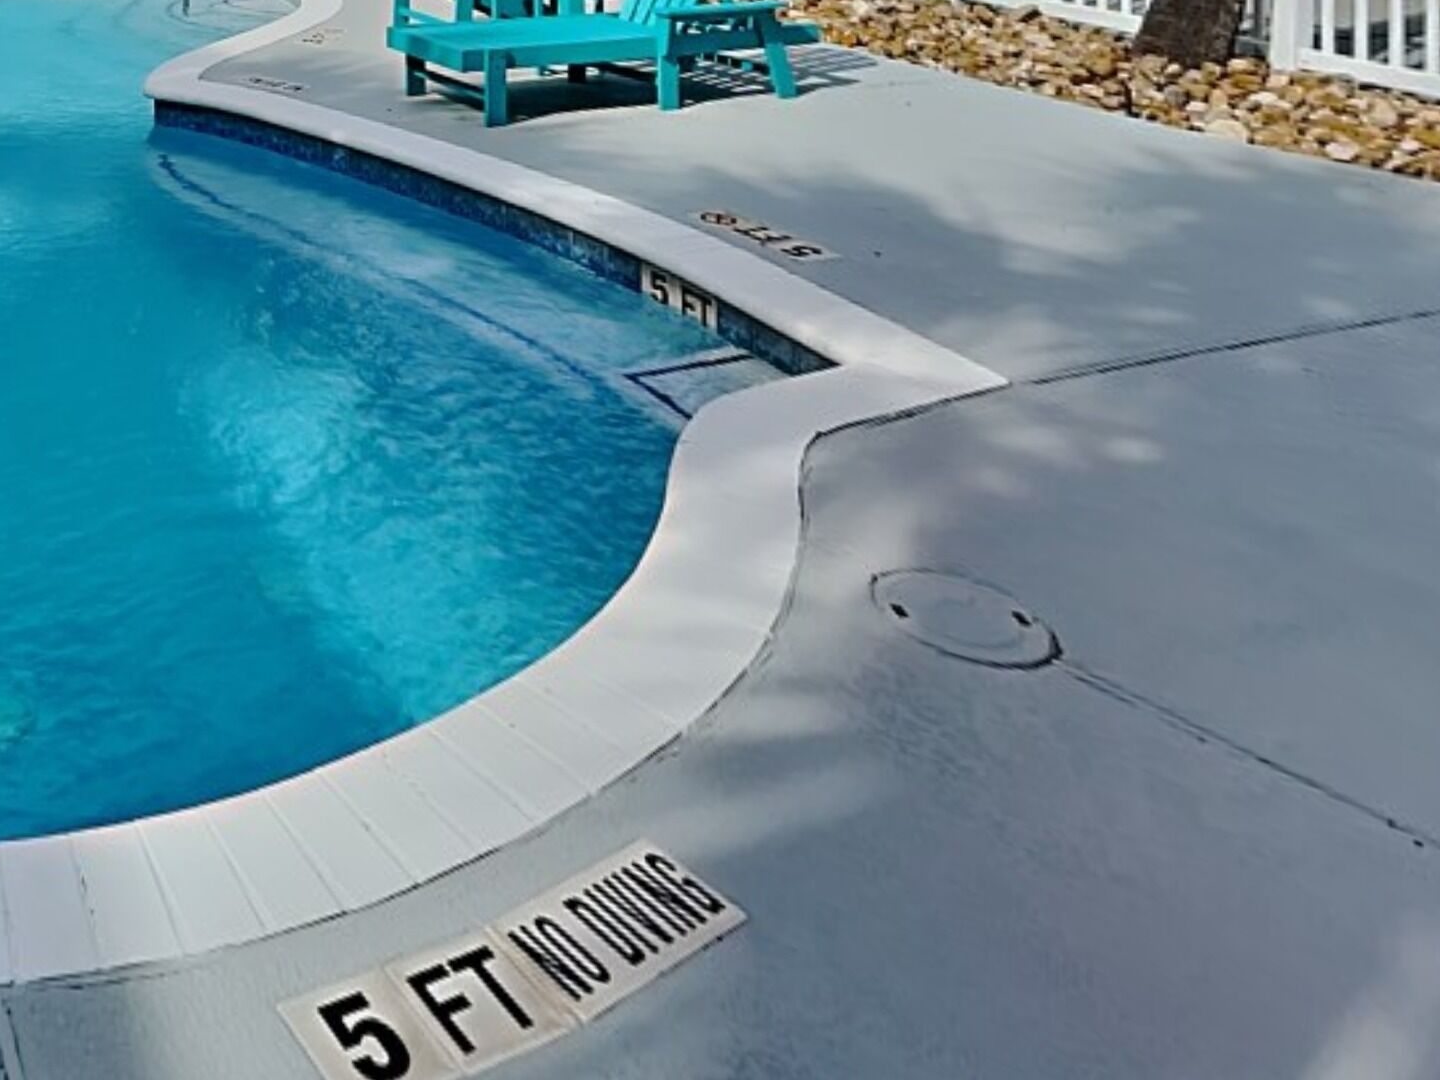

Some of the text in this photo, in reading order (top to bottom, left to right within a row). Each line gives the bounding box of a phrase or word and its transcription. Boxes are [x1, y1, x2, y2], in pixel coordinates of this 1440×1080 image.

[650, 270, 712, 327] 5 FT
[317, 852, 727, 1080] 5 FT NO DIVING
